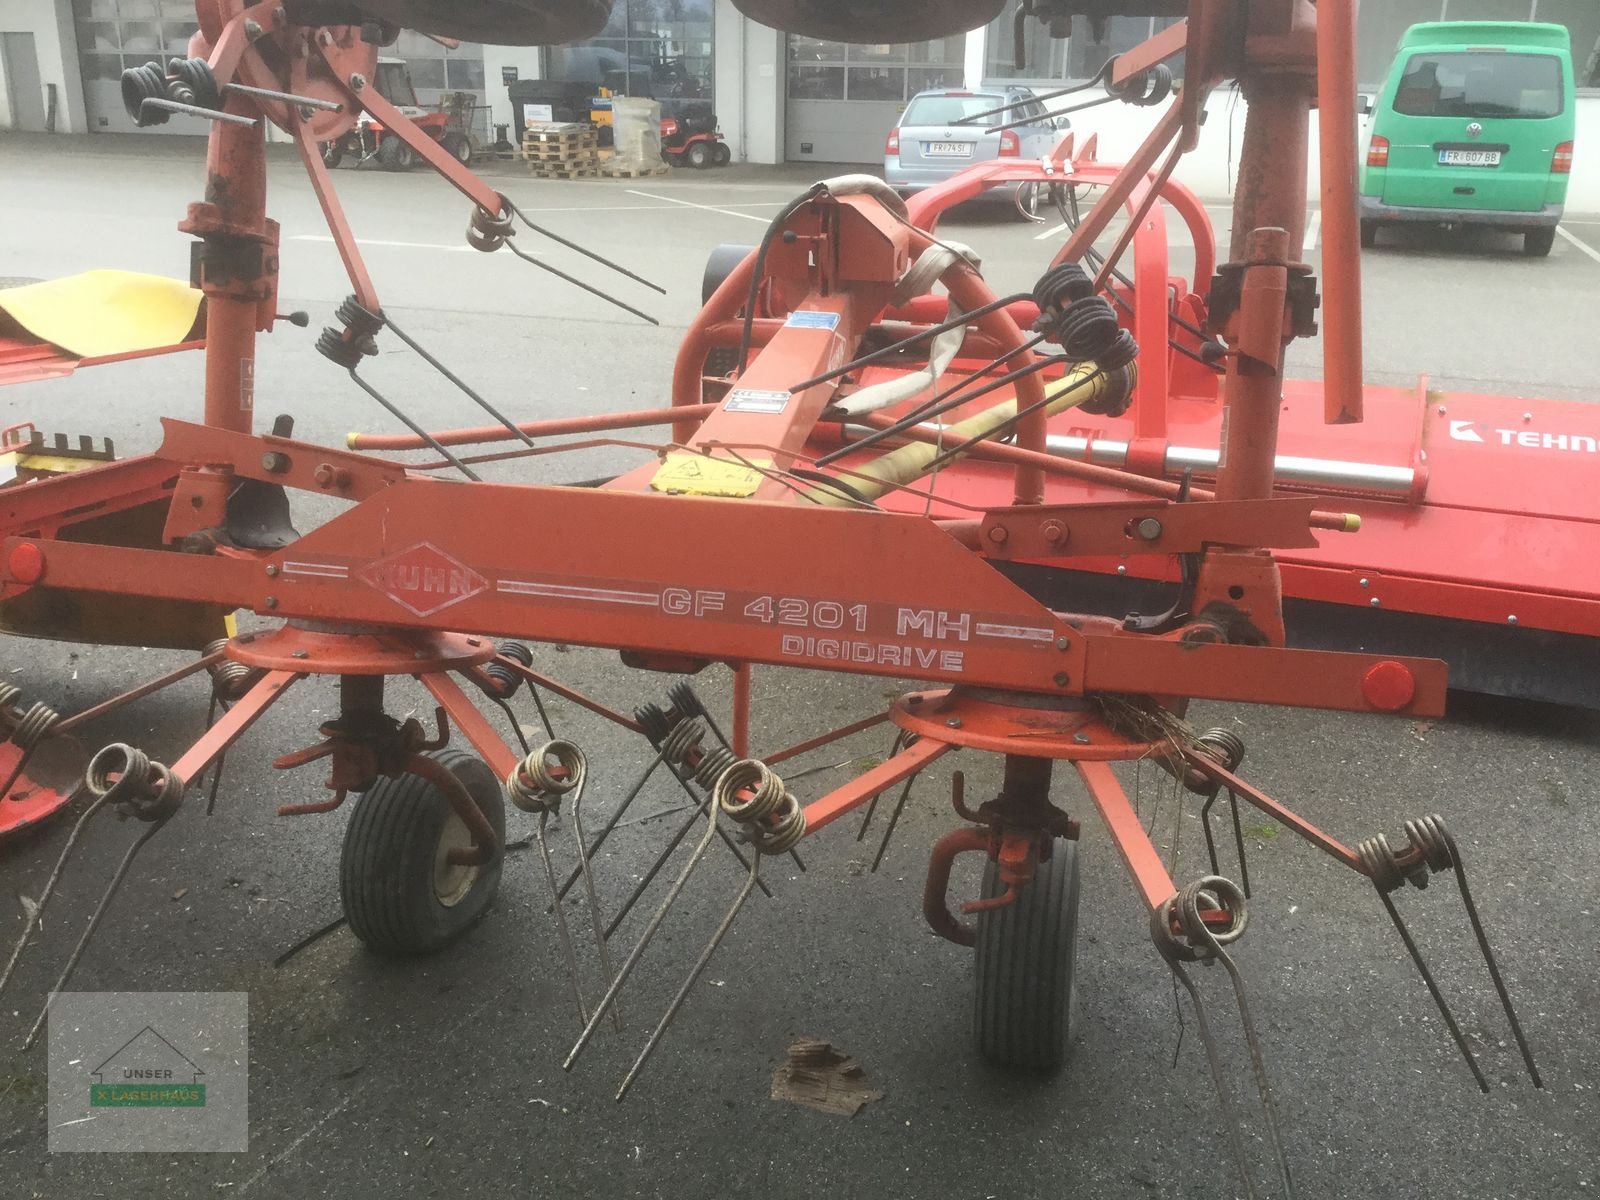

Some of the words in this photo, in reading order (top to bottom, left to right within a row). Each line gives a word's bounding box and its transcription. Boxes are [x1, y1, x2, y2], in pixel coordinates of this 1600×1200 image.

[933, 143, 943, 152] FR
[1448, 151, 1459, 161] FR
[1465, 152, 1483, 161] 607
[1495, 428, 1600, 453] TEHN
[661, 587, 726, 617] GF
[743, 596, 868, 632] 4201
[896, 607, 970, 641] MH
[781, 634, 965, 672] DIGIDRIVE
